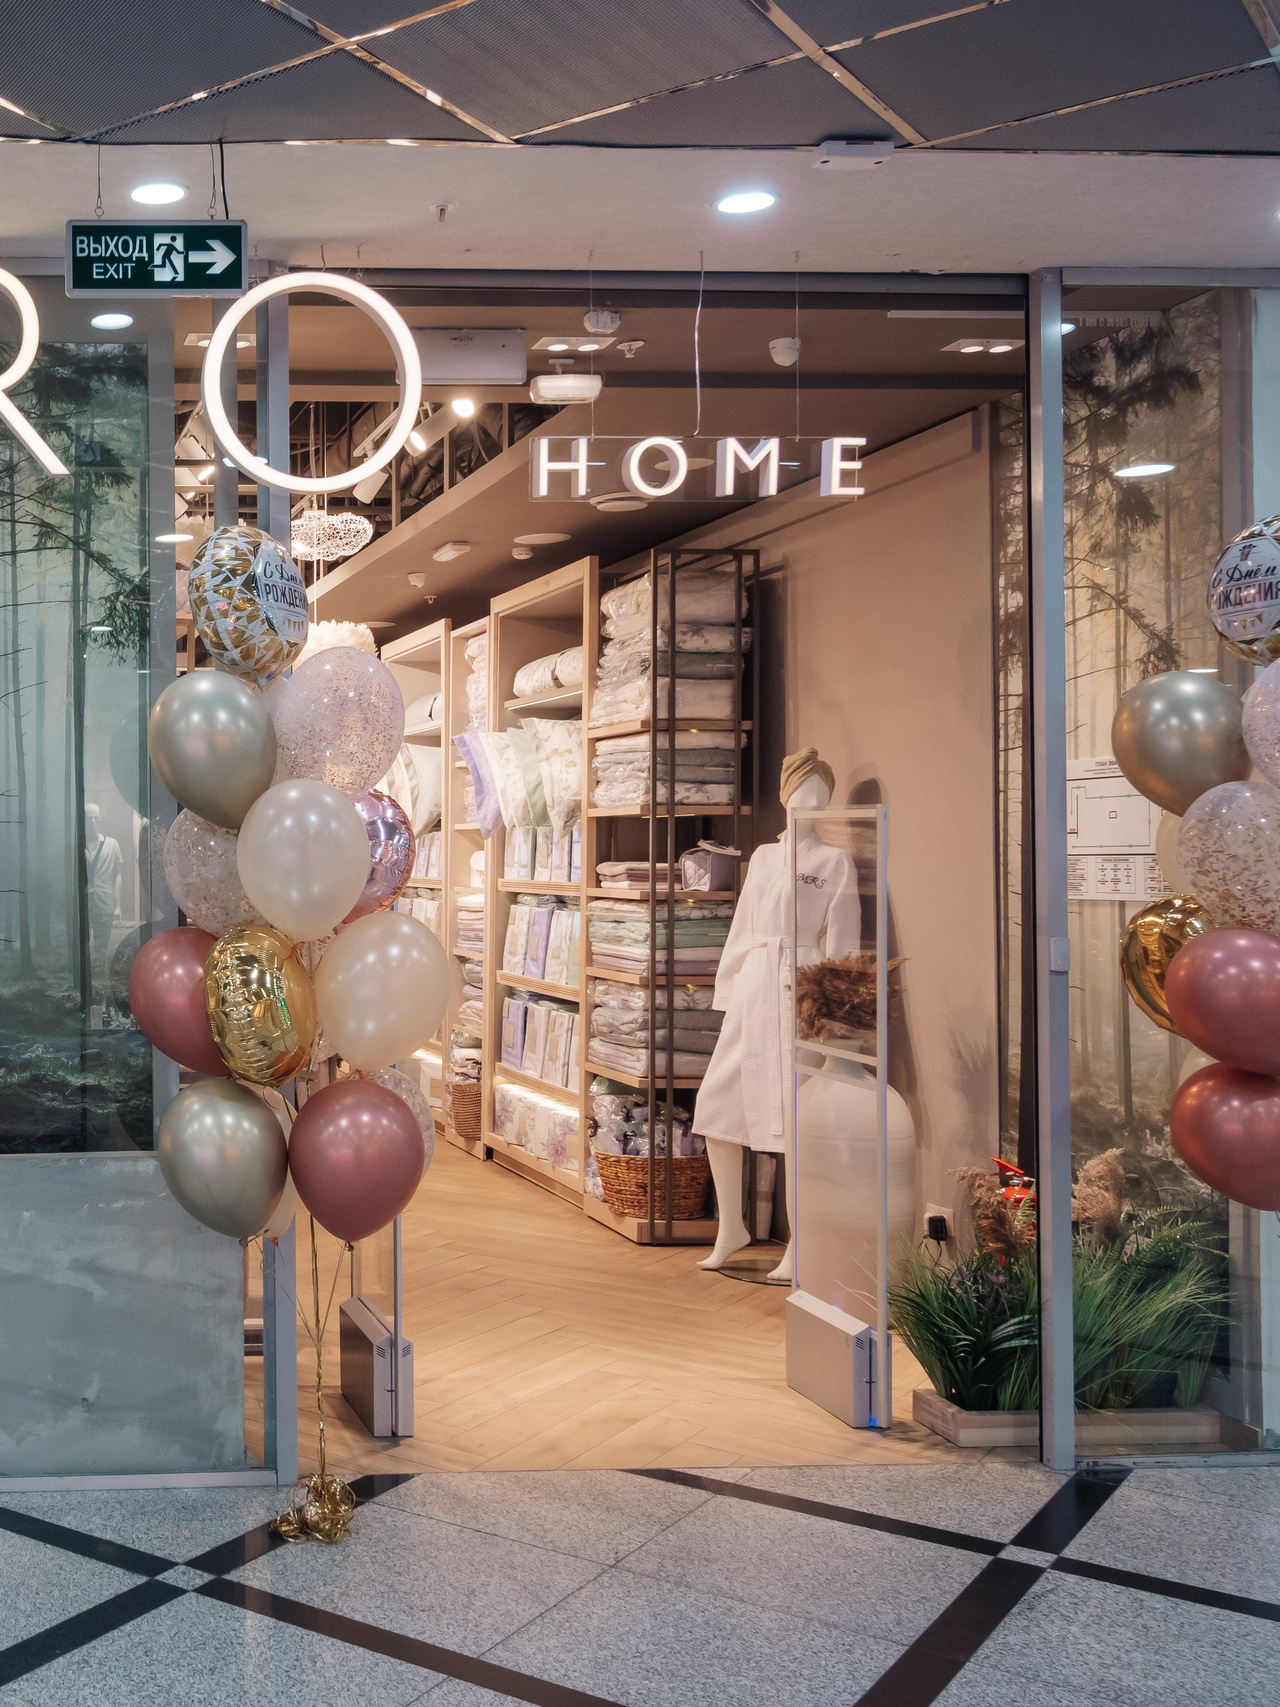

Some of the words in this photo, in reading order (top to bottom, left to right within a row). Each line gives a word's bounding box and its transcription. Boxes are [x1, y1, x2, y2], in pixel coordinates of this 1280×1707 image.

[76, 235, 149, 262] ВЫХОД
[93, 263, 136, 279] EXIT
[536, 437, 868, 498] HOME
[264, 583, 309, 613] РОЖДЕНИ
